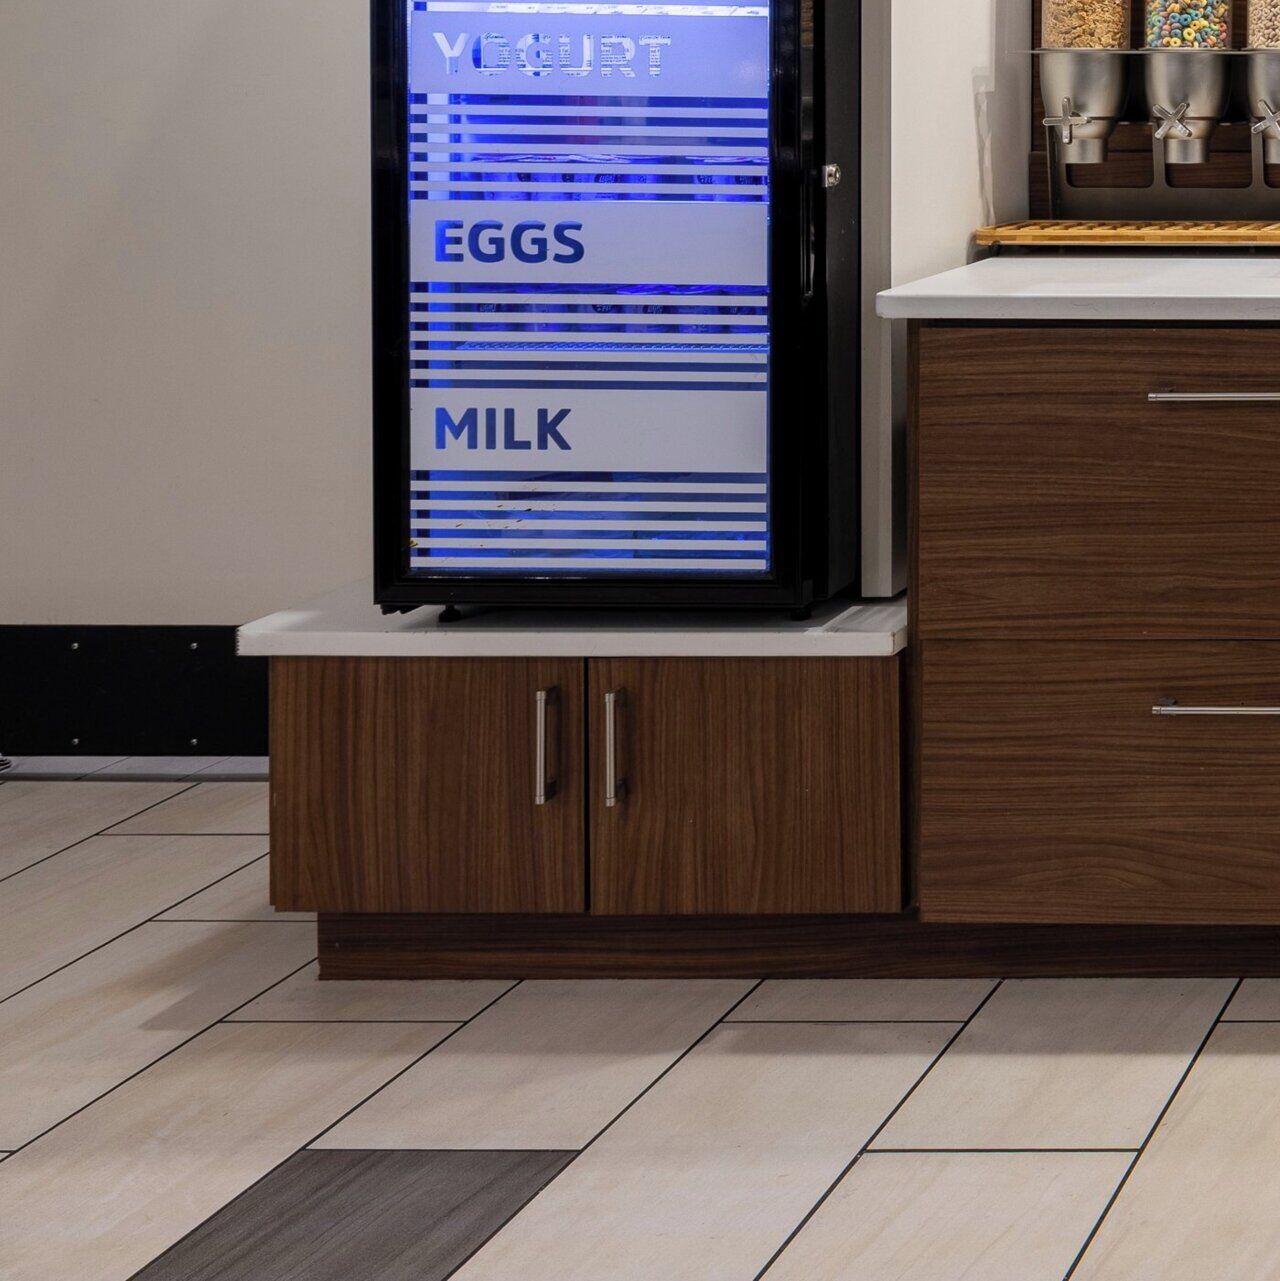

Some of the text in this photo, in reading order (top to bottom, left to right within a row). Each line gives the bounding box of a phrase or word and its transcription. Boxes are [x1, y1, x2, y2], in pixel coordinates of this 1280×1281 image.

[432, 32, 672, 78] YOGURT
[435, 220, 585, 264] EGGS
[435, 407, 572, 450] MILK
